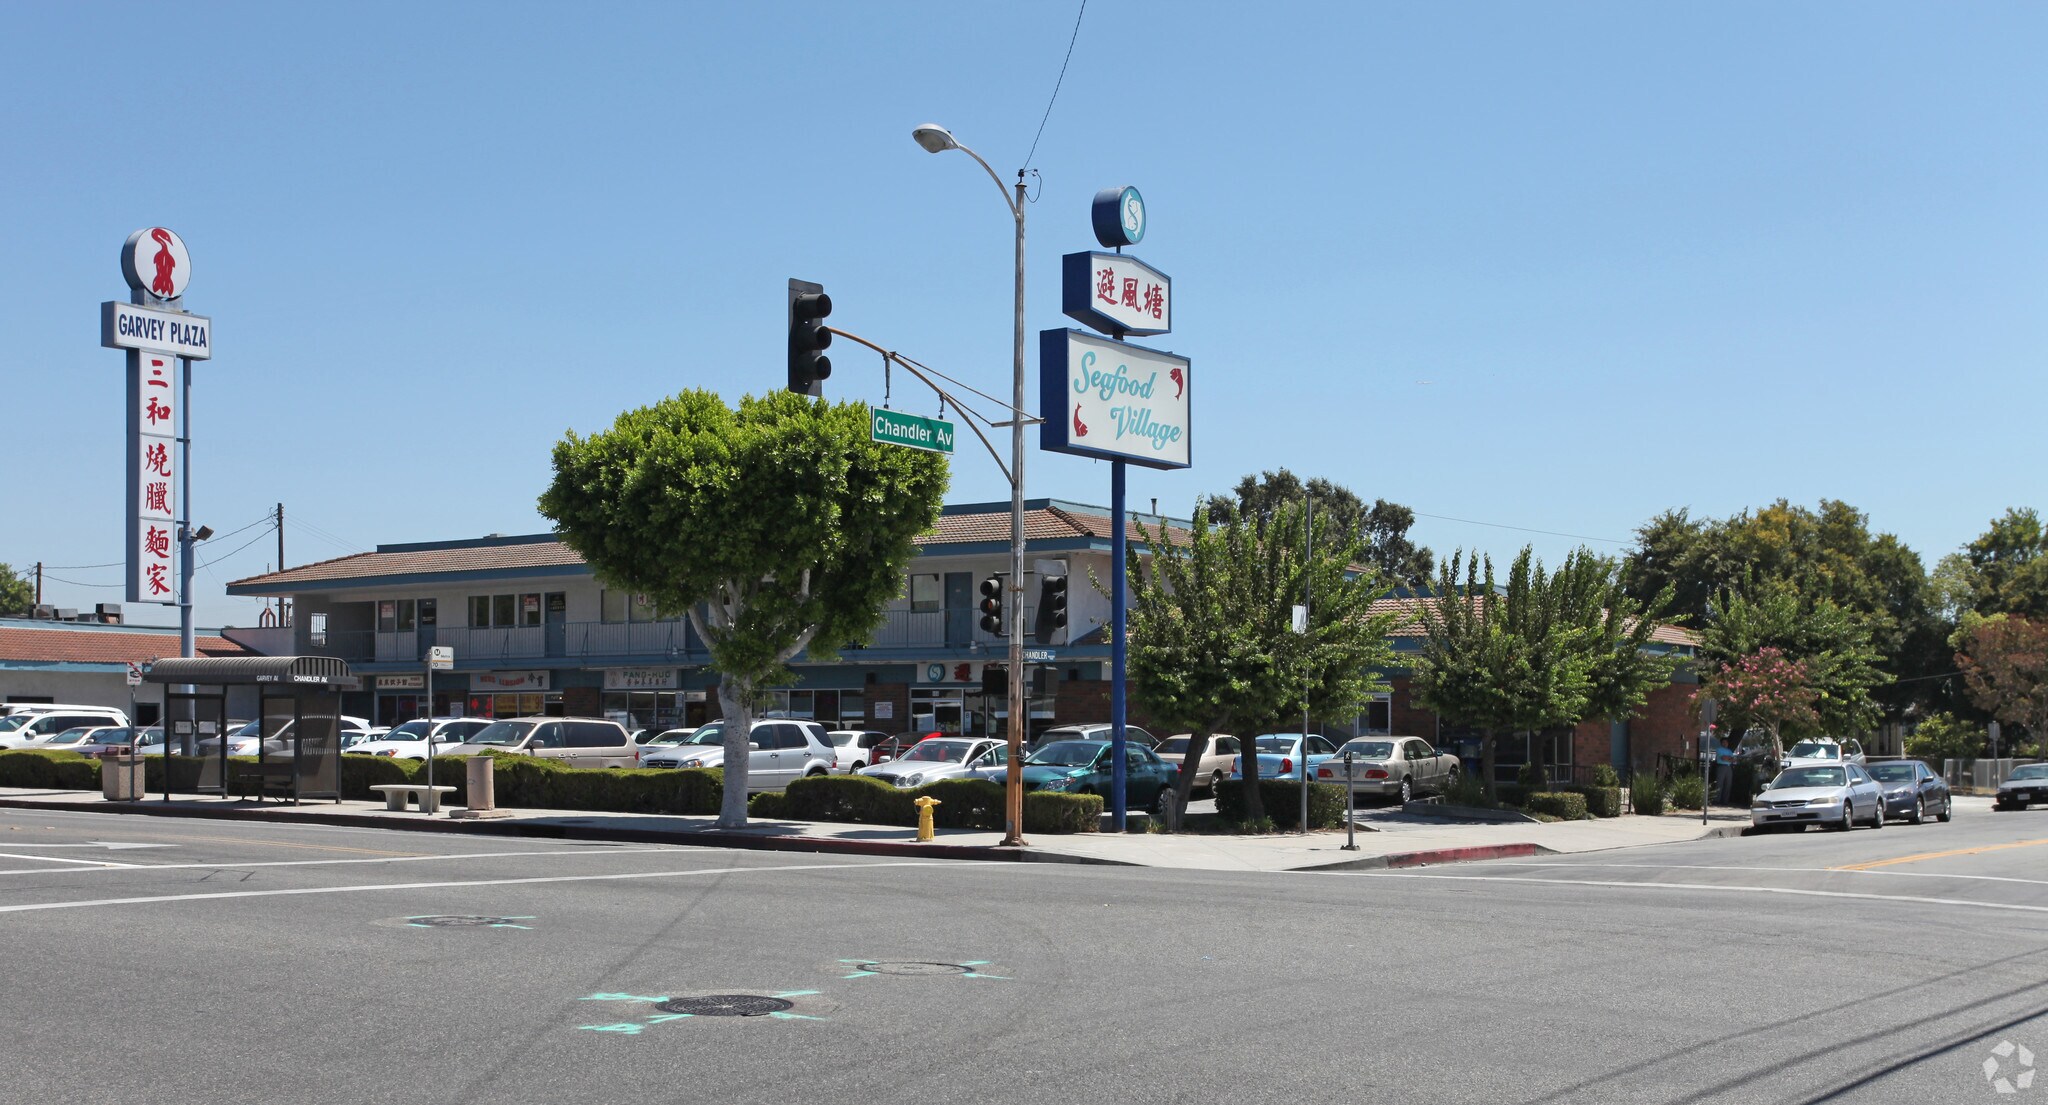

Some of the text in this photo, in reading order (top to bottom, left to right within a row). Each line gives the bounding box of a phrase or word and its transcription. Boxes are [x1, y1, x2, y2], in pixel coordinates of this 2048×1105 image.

[1097, 267, 1164, 320] 避風塘
[119, 313, 207, 348] GARVEY PLAZA
[1073, 351, 1157, 401] Seafood
[875, 416, 952, 446] Chandler Av
[1110, 405, 1182, 451] Village
[144, 359, 172, 595] 三和燒臘麵家
[293, 675, 320, 683] CHANDLER
